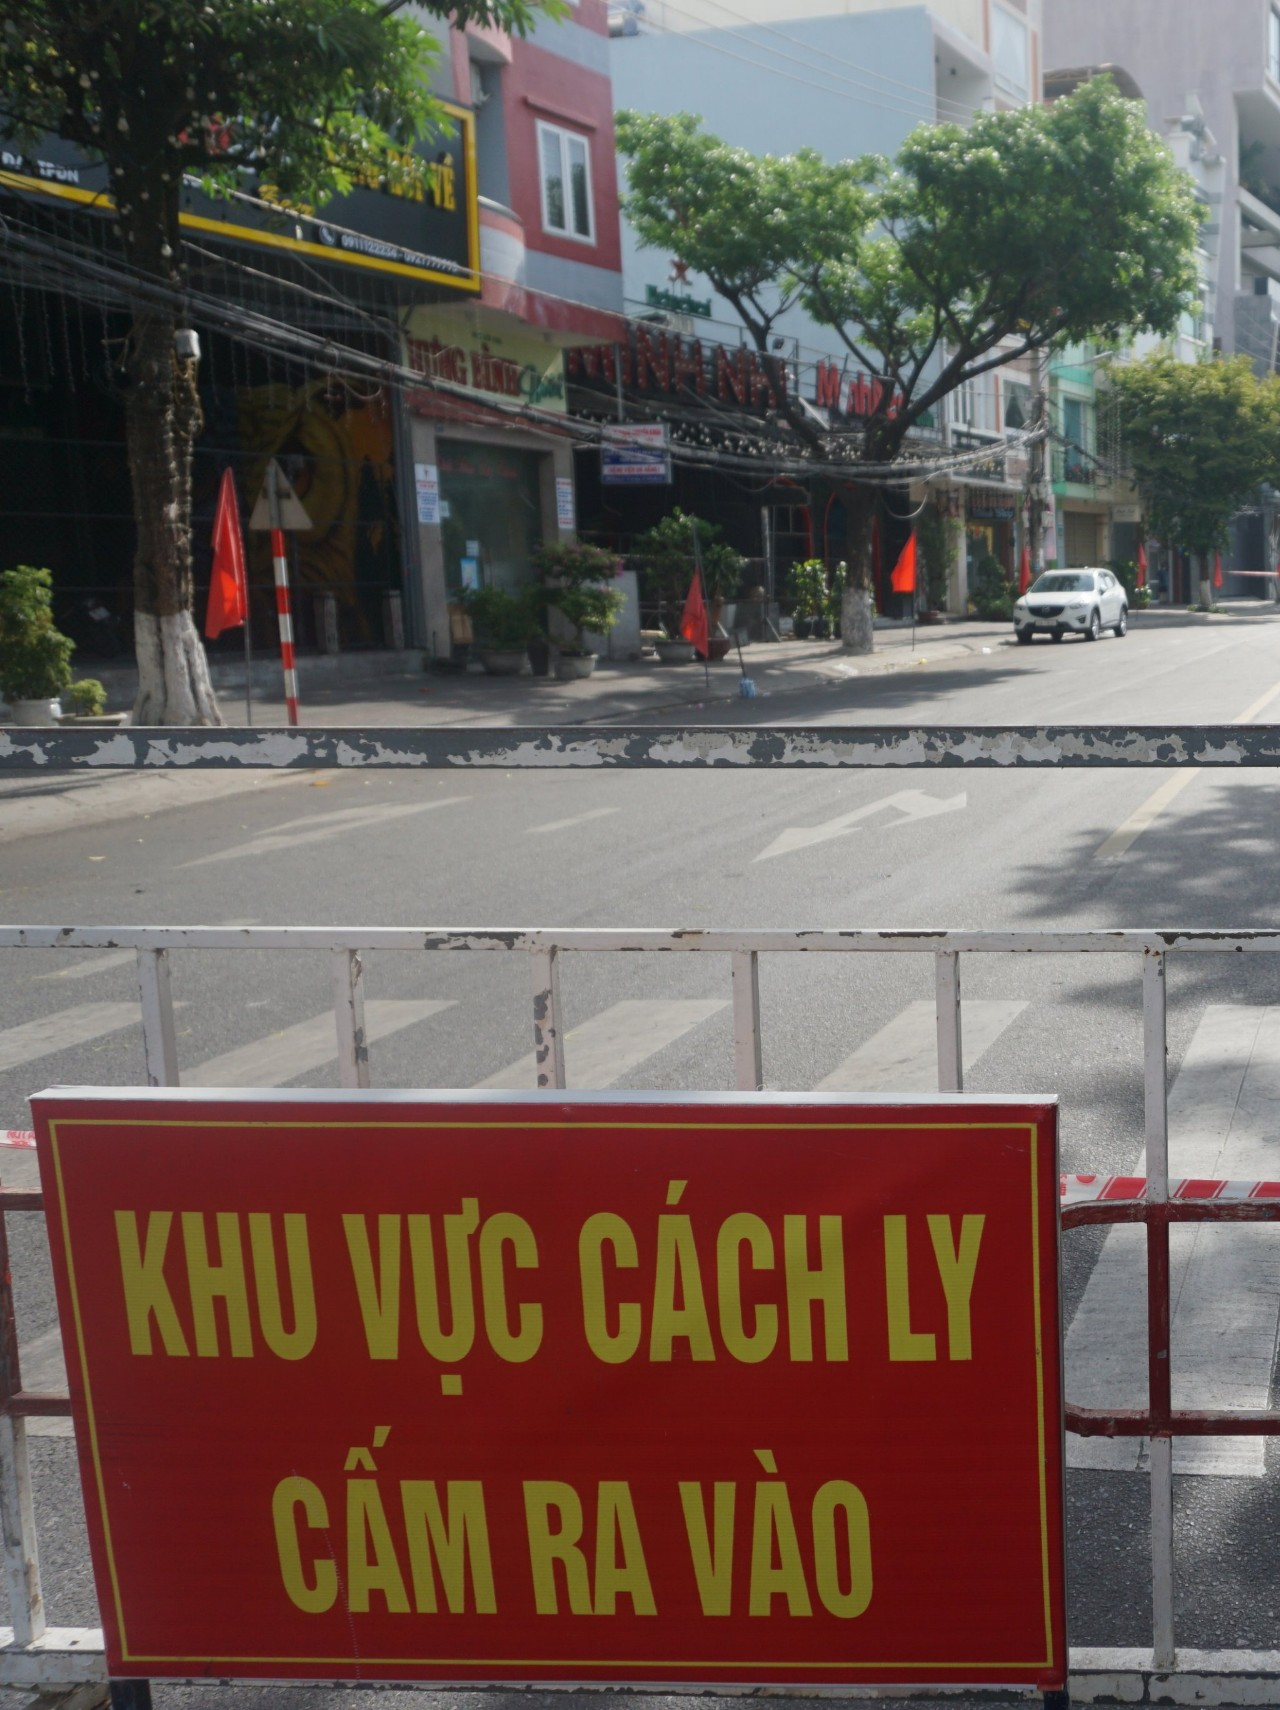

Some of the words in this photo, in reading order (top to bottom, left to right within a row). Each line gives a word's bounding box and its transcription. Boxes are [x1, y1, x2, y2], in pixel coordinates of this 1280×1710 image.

[115, 1211, 317, 1360] KHU
[343, 1198, 543, 1395] VỰC
[578, 1180, 849, 1363] CÁCH
[884, 1214, 986, 1361] LY
[272, 1426, 497, 1615] CẤM
[523, 1481, 657, 1616] RA
[680, 1450, 873, 1619] VÀO
